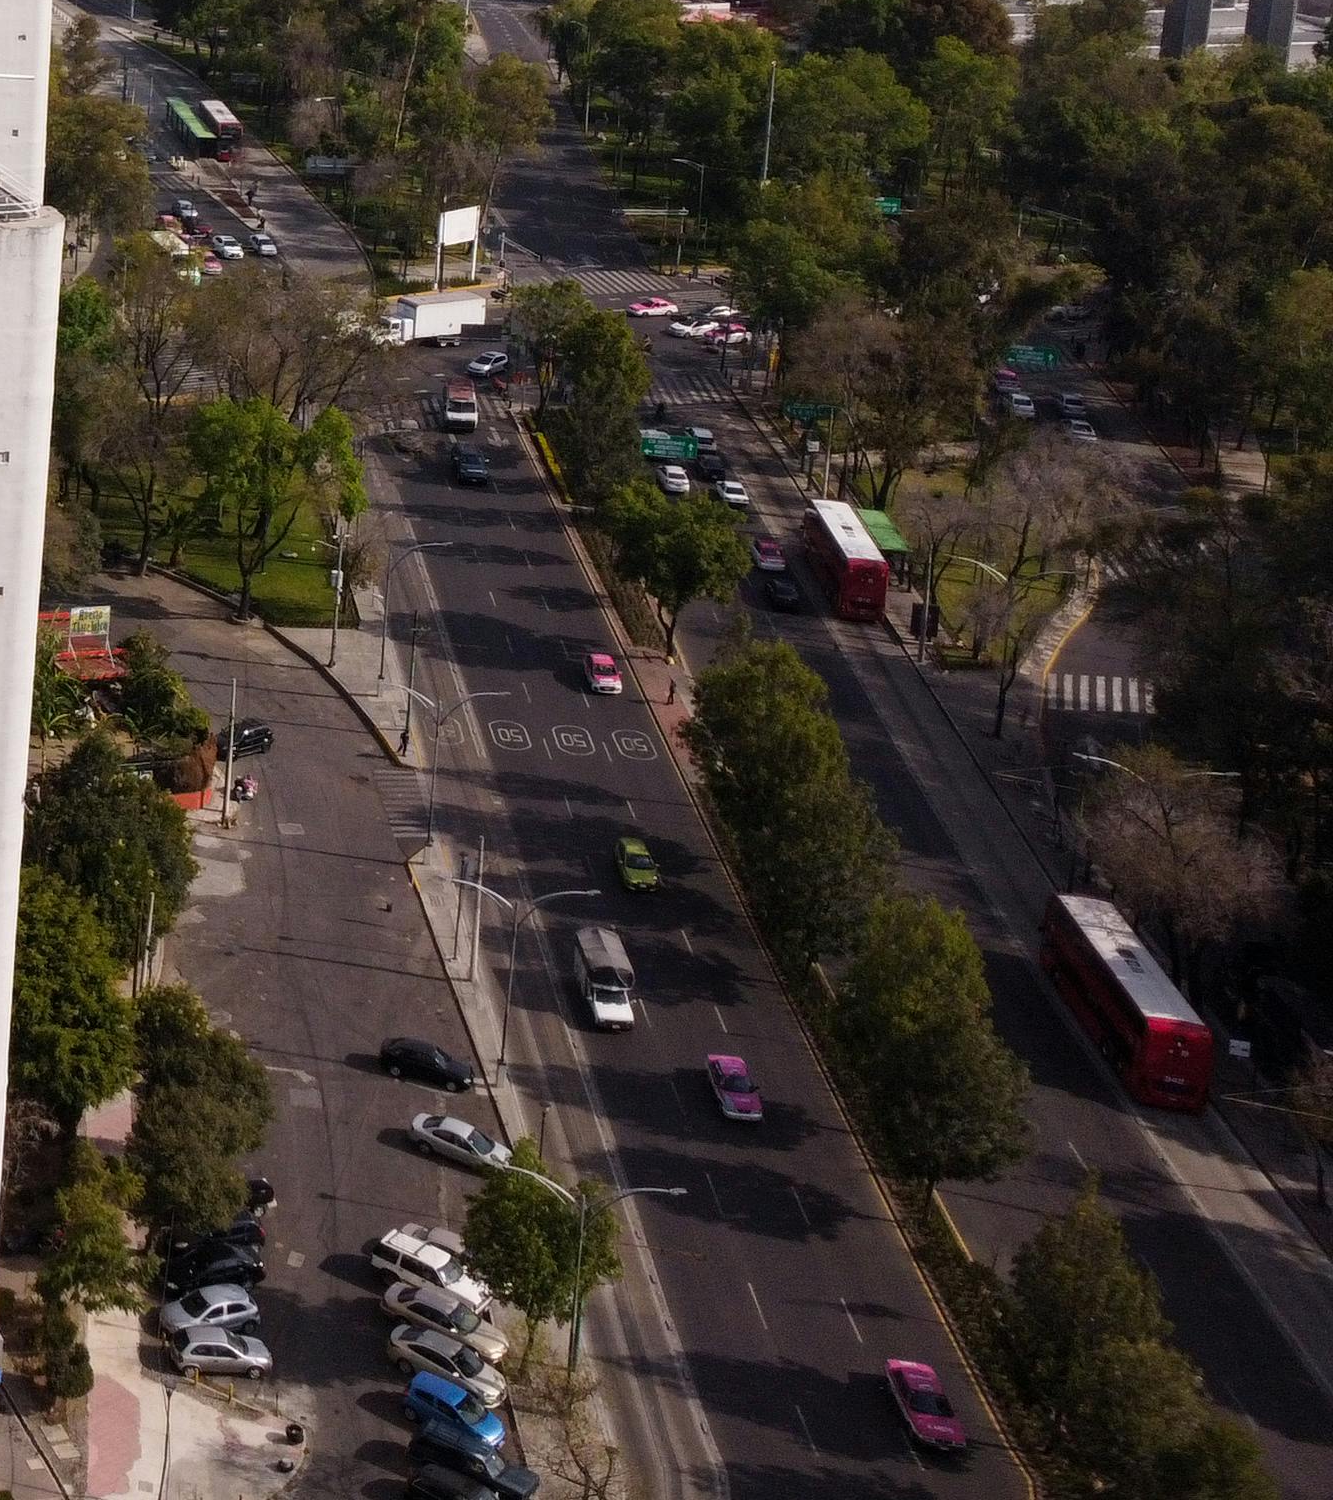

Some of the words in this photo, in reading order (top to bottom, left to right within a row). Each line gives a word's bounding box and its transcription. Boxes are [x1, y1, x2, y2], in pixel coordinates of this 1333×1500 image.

[497, 728, 523, 743] 50
[560, 733, 586, 748] 50
[621, 737, 647, 752] 50
